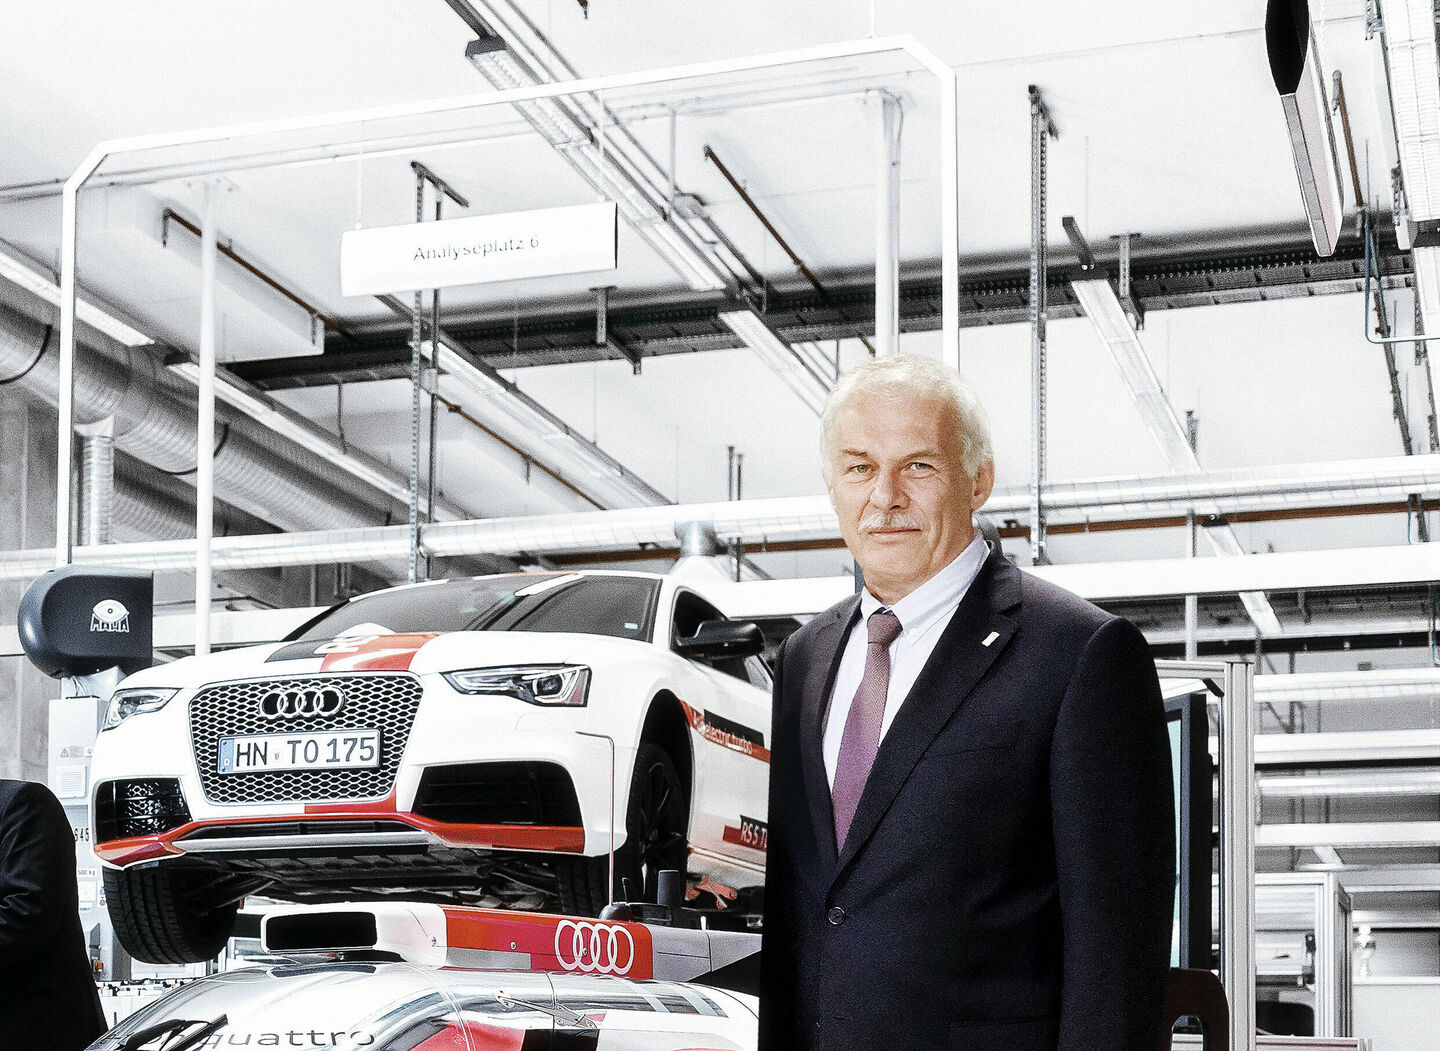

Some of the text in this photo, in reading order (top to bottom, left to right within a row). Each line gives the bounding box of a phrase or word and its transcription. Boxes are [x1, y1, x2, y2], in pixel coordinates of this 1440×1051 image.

[413, 234, 540, 261] Analyseplatz 6
[236, 737, 376, 767] HN TO 175
[207, 1029, 375, 1050] quattro
